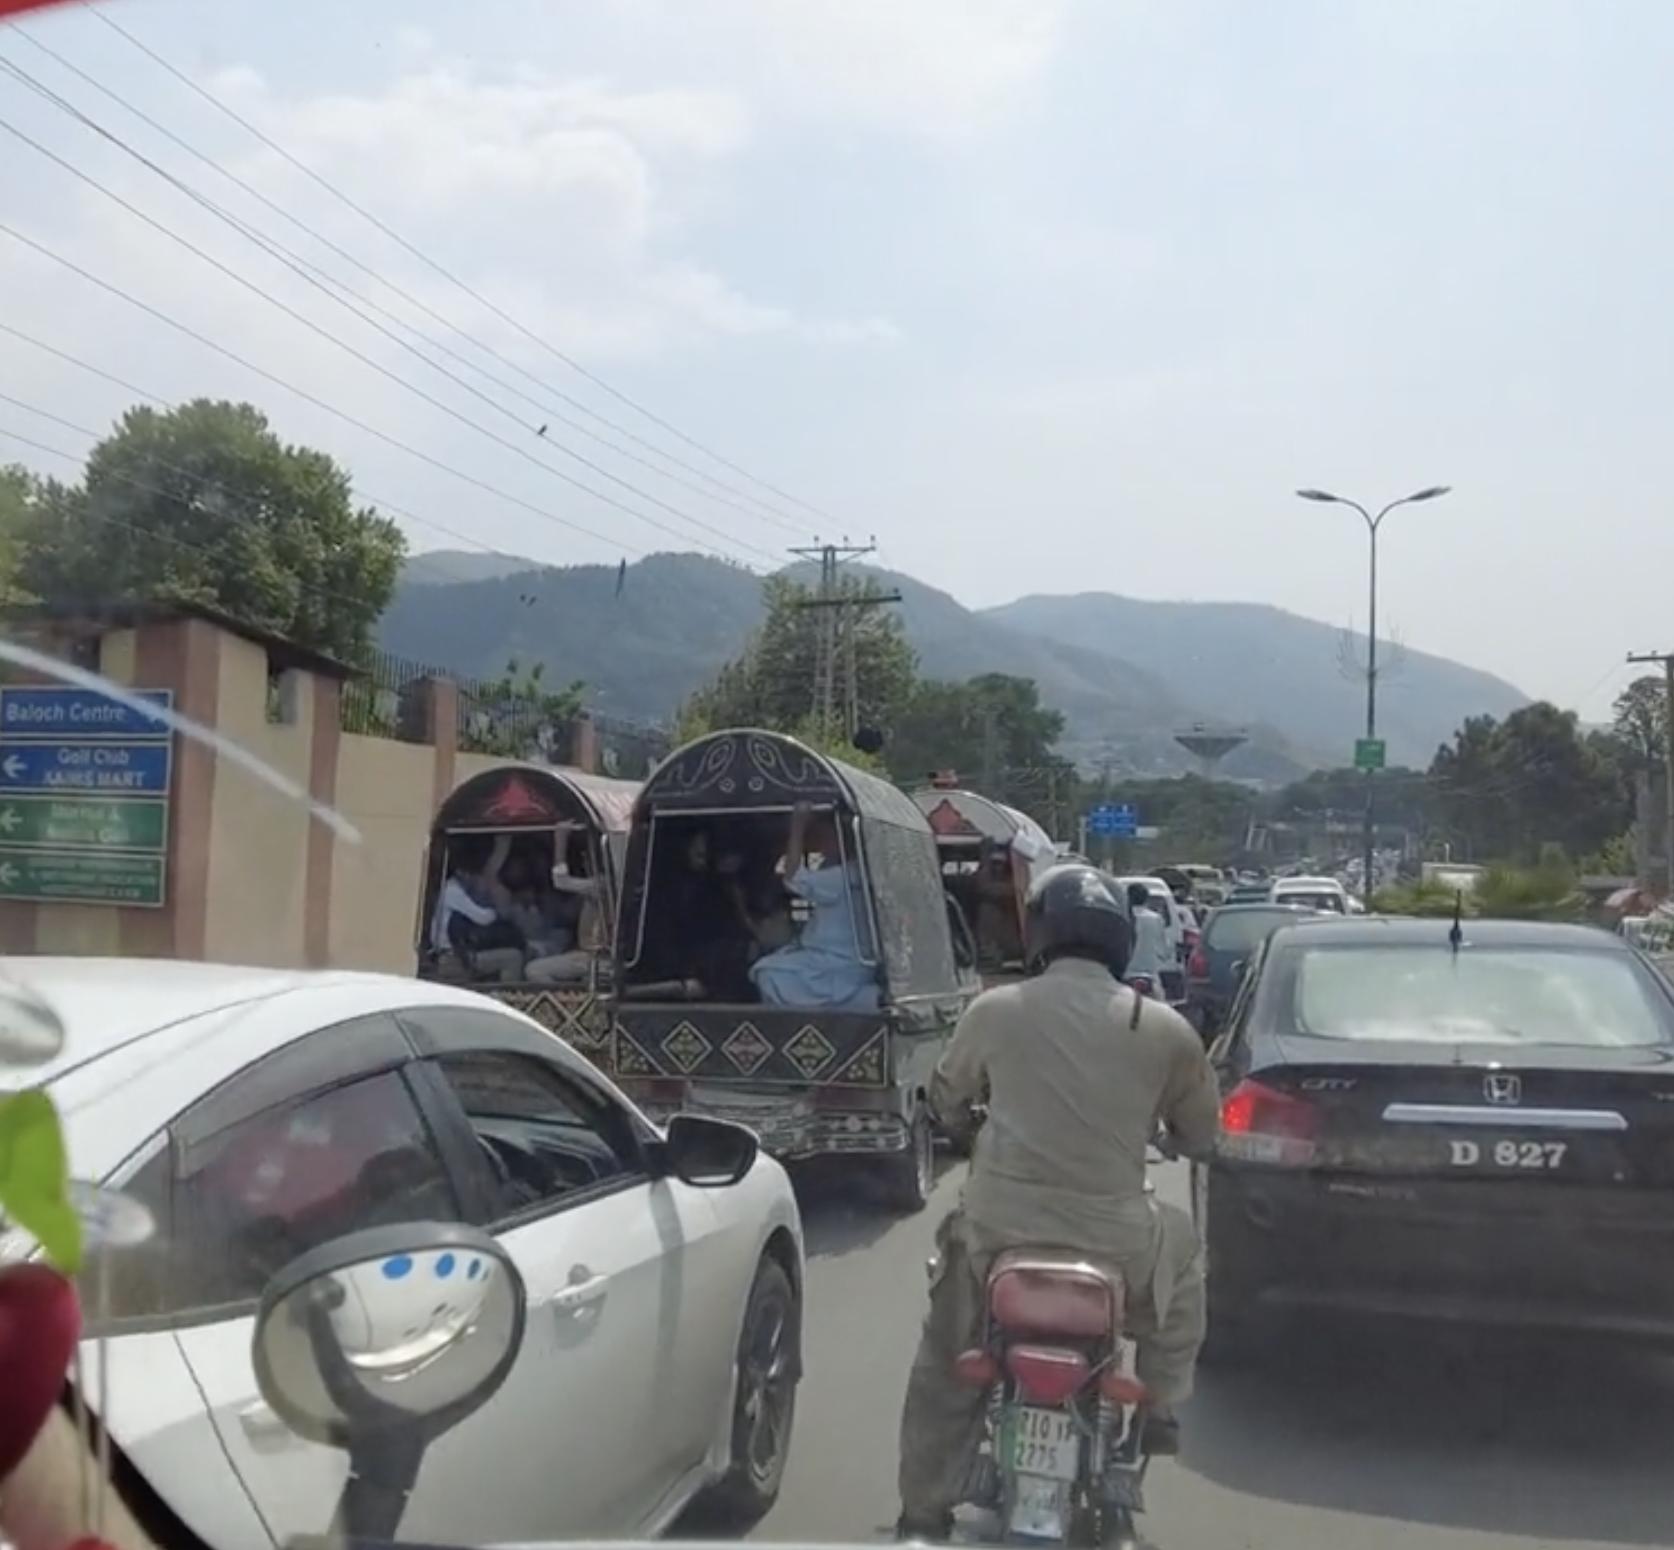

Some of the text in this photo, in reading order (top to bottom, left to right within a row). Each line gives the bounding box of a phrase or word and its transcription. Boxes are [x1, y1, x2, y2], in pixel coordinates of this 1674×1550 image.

[6, 702, 127, 722] Baloch Centre
[57, 748, 129, 765] Golf Club
[1301, 1077, 1357, 1091] CITY
[1450, 1140, 1567, 1168] D 827
